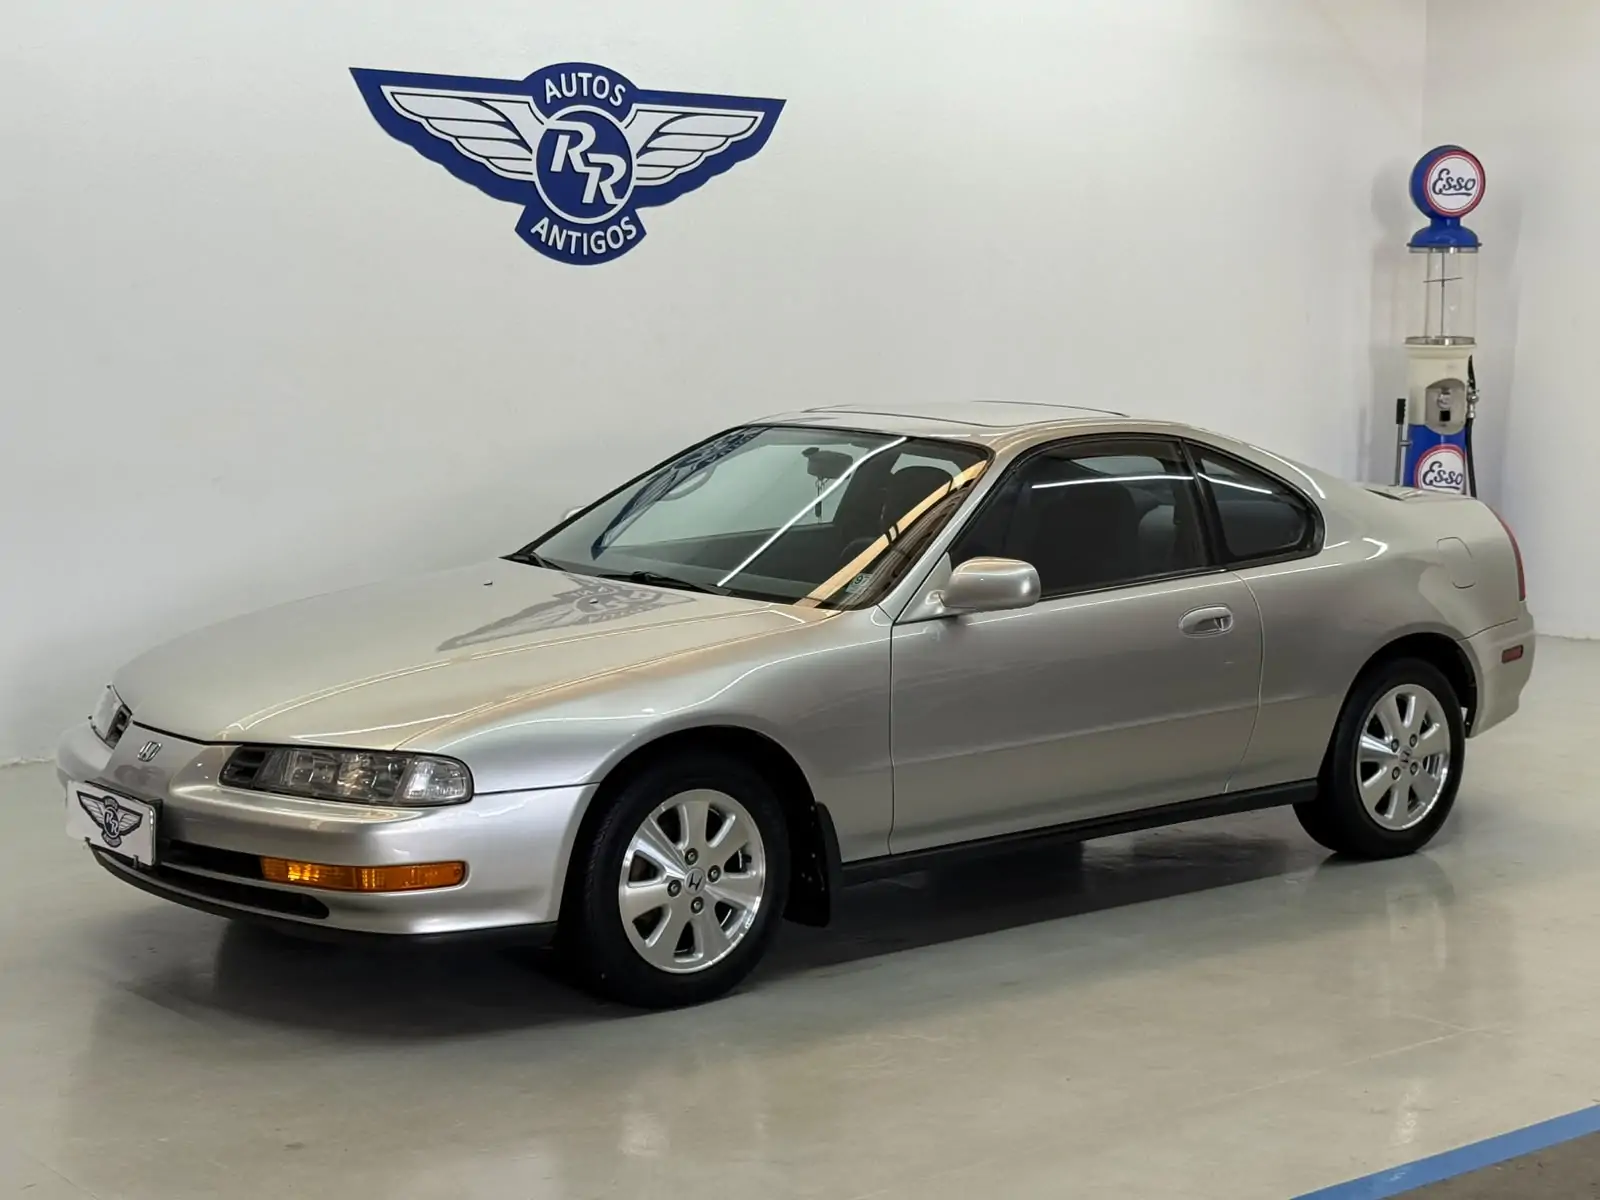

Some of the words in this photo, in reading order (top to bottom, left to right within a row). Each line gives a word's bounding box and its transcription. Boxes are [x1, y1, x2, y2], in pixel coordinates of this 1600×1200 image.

[545, 72, 626, 106] AUTOS
[545, 120, 627, 204] RR
[1431, 168, 1476, 196] Esso
[530, 217, 637, 255] ANTIGOS
[1422, 461, 1464, 490] Esso
